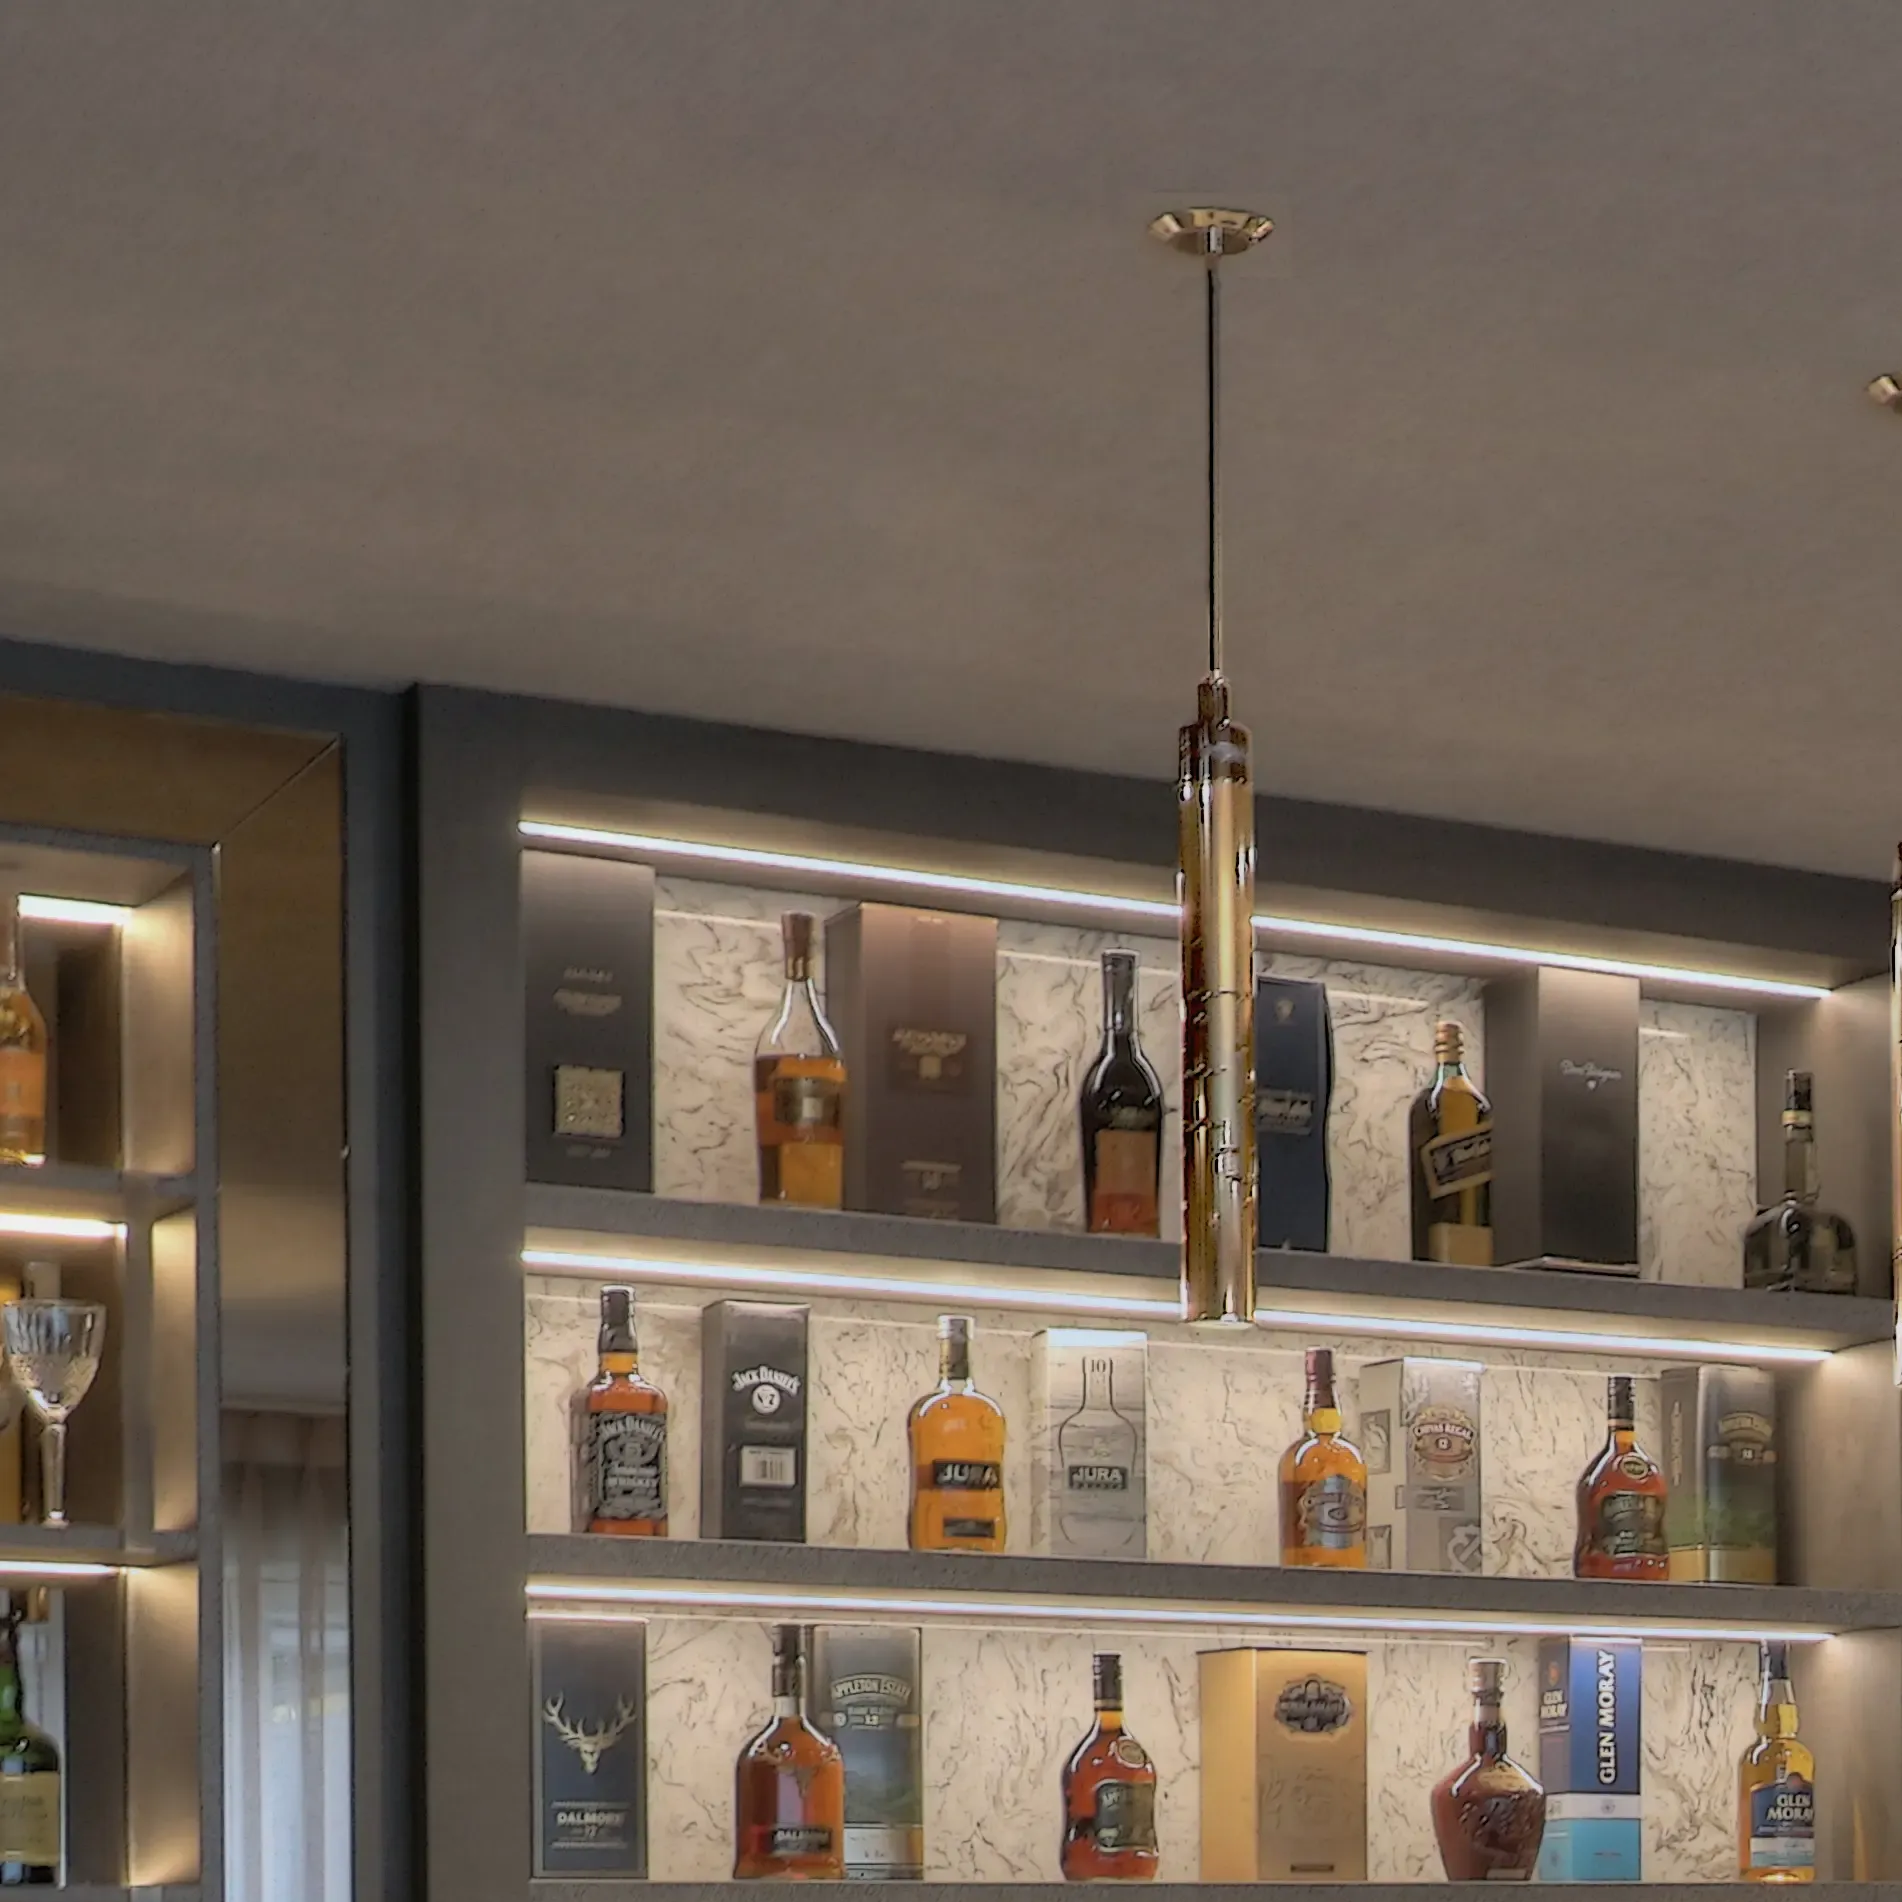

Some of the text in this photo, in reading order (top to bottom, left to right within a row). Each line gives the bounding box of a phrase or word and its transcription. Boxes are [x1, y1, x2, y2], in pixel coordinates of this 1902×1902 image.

[732, 1365, 801, 1396] JACK DANIEL'S
[1071, 1466, 1122, 1482] JURA
[1597, 1649, 1616, 1785] GLEN MORAY
